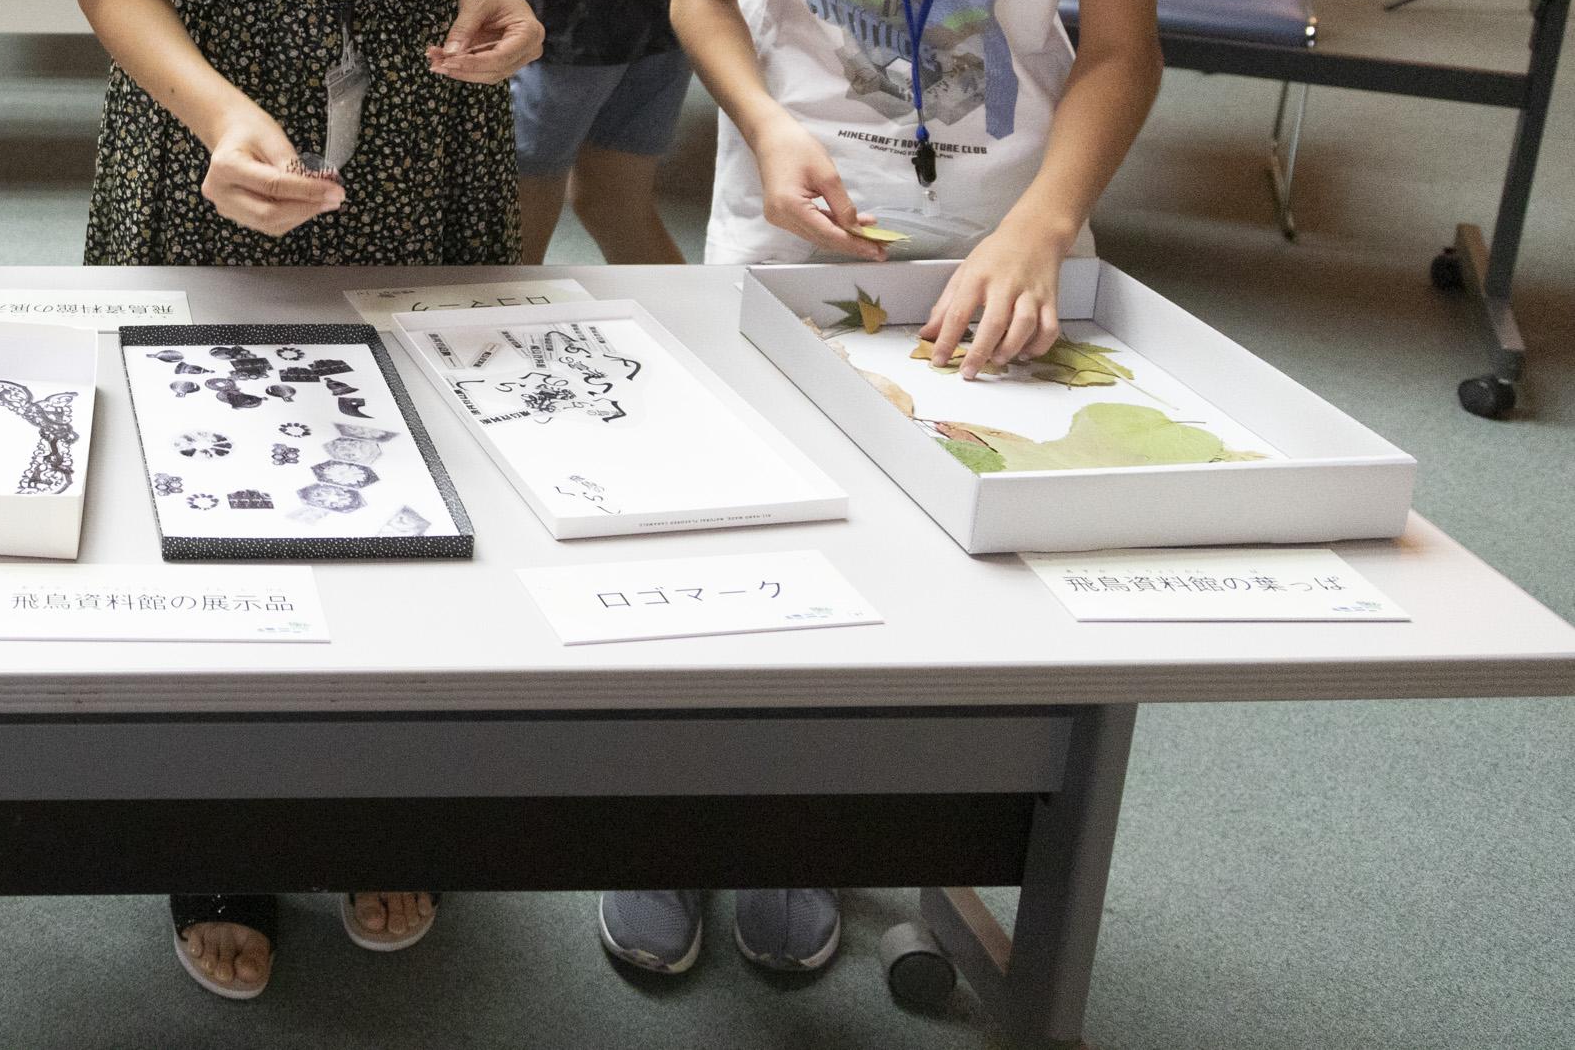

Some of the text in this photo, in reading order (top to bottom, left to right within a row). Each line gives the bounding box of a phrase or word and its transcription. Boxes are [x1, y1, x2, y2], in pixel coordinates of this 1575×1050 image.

[837, 130, 900, 147] MINECRAFT
[961, 145, 988, 155] CLUB
[11, 593, 294, 612] 飛鳥資料館の展示品
[596, 580, 781, 608] ロゴマーク
